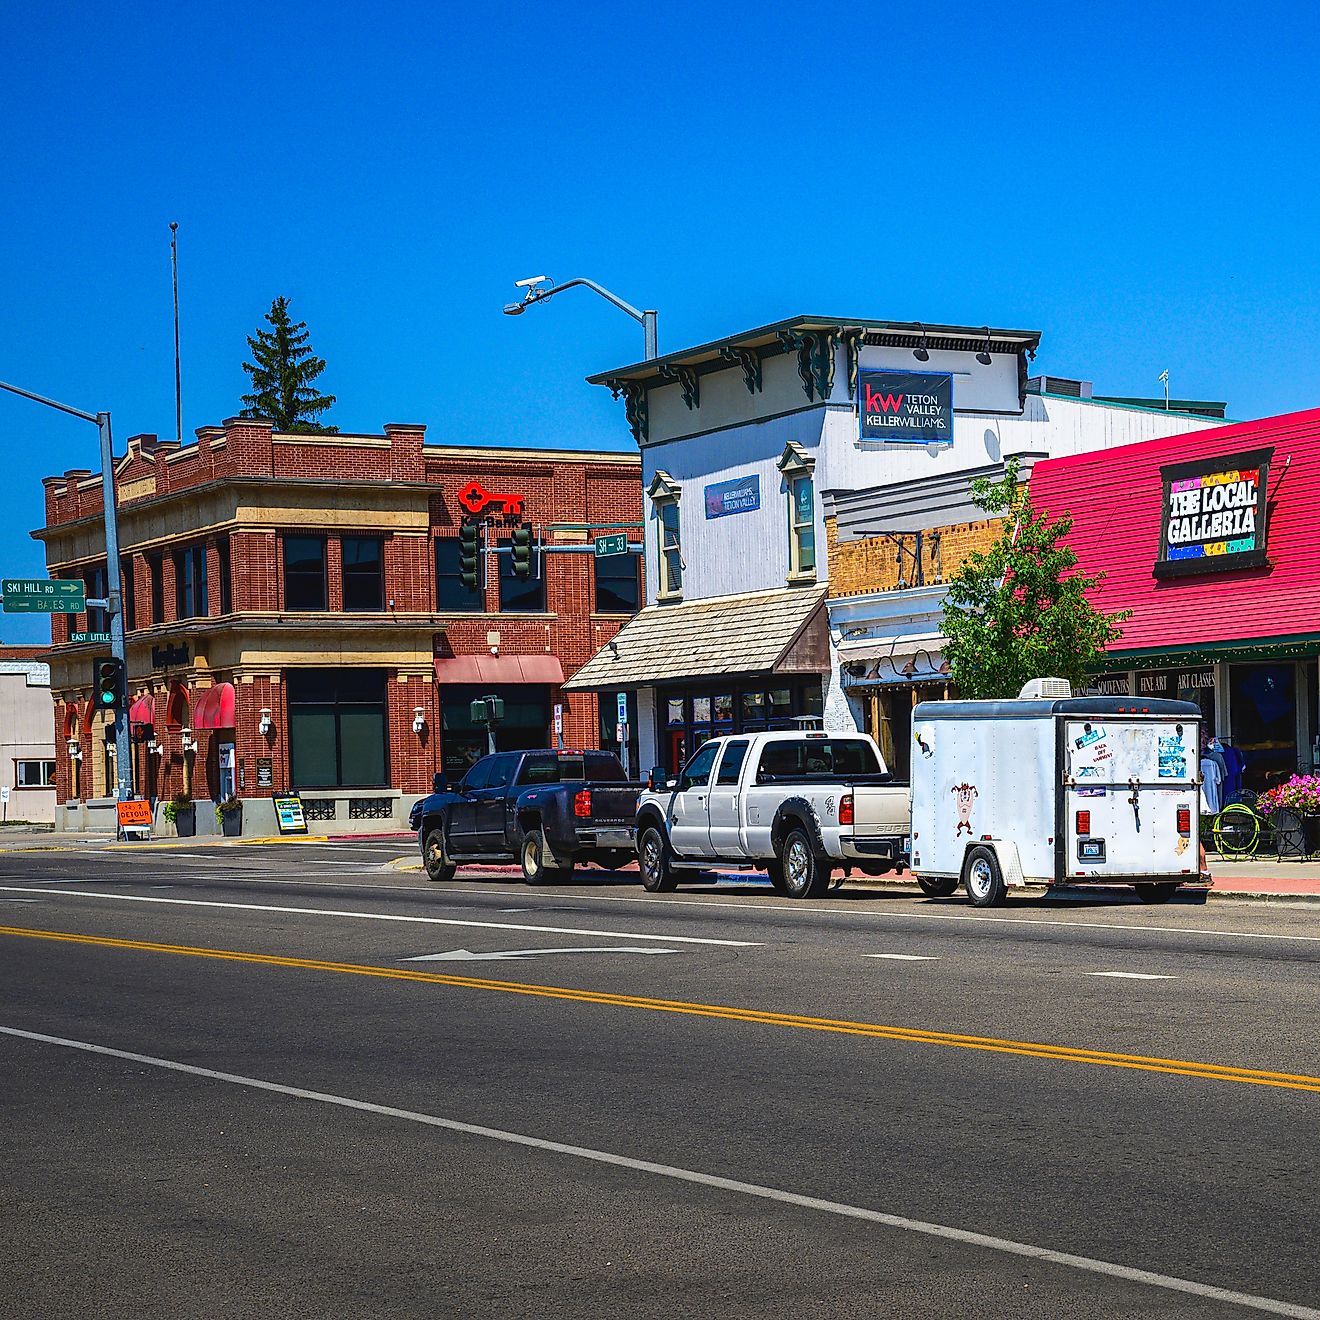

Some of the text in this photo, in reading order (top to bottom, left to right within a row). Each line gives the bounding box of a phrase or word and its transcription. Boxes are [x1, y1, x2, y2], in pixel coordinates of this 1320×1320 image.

[865, 383, 904, 413] kw
[905, 394, 938, 405] TETON
[906, 404, 942, 416] VALLEY
[1170, 480, 1258, 517] THE LOCAL
[1167, 507, 1256, 544] GALLERIA
[7, 583, 54, 594] SKI HILL RD
[37, 600, 65, 610] BAES
[71, 633, 110, 641] EAST LITTLE
[1140, 675, 1168, 692] FINE ART
[1178, 672, 1216, 690] ART CLASSES
[876, 825, 909, 833] SUPE
